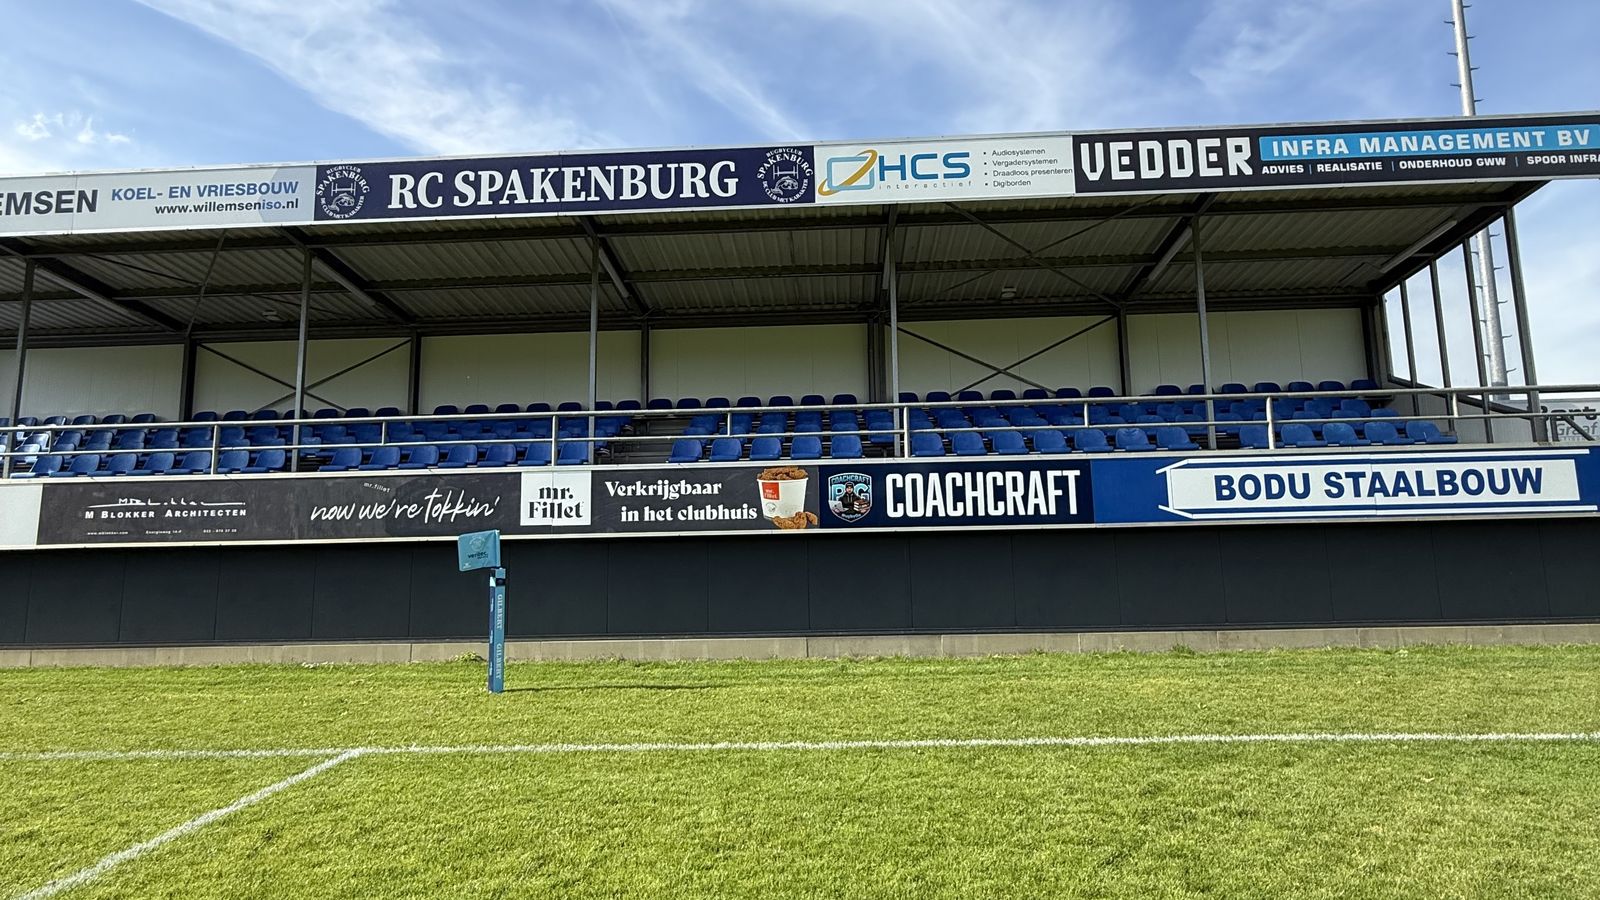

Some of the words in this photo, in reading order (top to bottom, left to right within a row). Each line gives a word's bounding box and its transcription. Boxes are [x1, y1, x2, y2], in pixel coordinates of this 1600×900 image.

[992, 148, 1046, 157] Audiosystemen
[1272, 138, 1349, 157] INFRA
[1359, 131, 1545, 154] MANAGEMENT
[1557, 129, 1590, 146] BV
[757, 153, 814, 180] SPAKENBURG
[878, 152, 971, 182] HCS
[992, 158, 1058, 167] Vergadersystemen
[1080, 136, 1253, 181] VEDDER
[1262, 164, 1304, 175] ADVIES
[1317, 161, 1383, 173] REALISATIE
[1399, 158, 1473, 170] ONDERHOUD
[1477, 157, 1506, 167] GWW
[1526, 155, 1566, 165] SPOOR
[1569, 154, 1600, 163] INFR
[993, 169, 1029, 177] Draadloos
[1031, 168, 1073, 176] presenteren
[111, 187, 163, 201] KOEL-
[168, 186, 191, 199] EN
[196, 181, 299, 198] VRIESBOUW
[316, 170, 370, 197] SPAKENBURG
[387, 171, 444, 209] RC
[453, 160, 739, 207] SPAKENBURG
[879, 181, 972, 189] interactief
[993, 180, 1032, 188] Digiborden
[0, 189, 98, 216] MSEN
[155, 198, 299, 215] www.willemseniso.nl
[605, 480, 722, 500] Verkrijgbaar
[831, 475, 869, 485] COACHCRAFT
[1214, 473, 1311, 501] BODU
[1324, 467, 1543, 499] STAALBOUW
[538, 487, 574, 500] mr.
[885, 469, 1081, 518] COACHCRAFT
[85, 510, 94, 519] M
[310, 503, 356, 521] now
[358, 498, 424, 519] we're
[528, 501, 583, 519] Fillet
[620, 505, 639, 522] in
[643, 506, 673, 522] het
[677, 503, 757, 521] clubhuis
